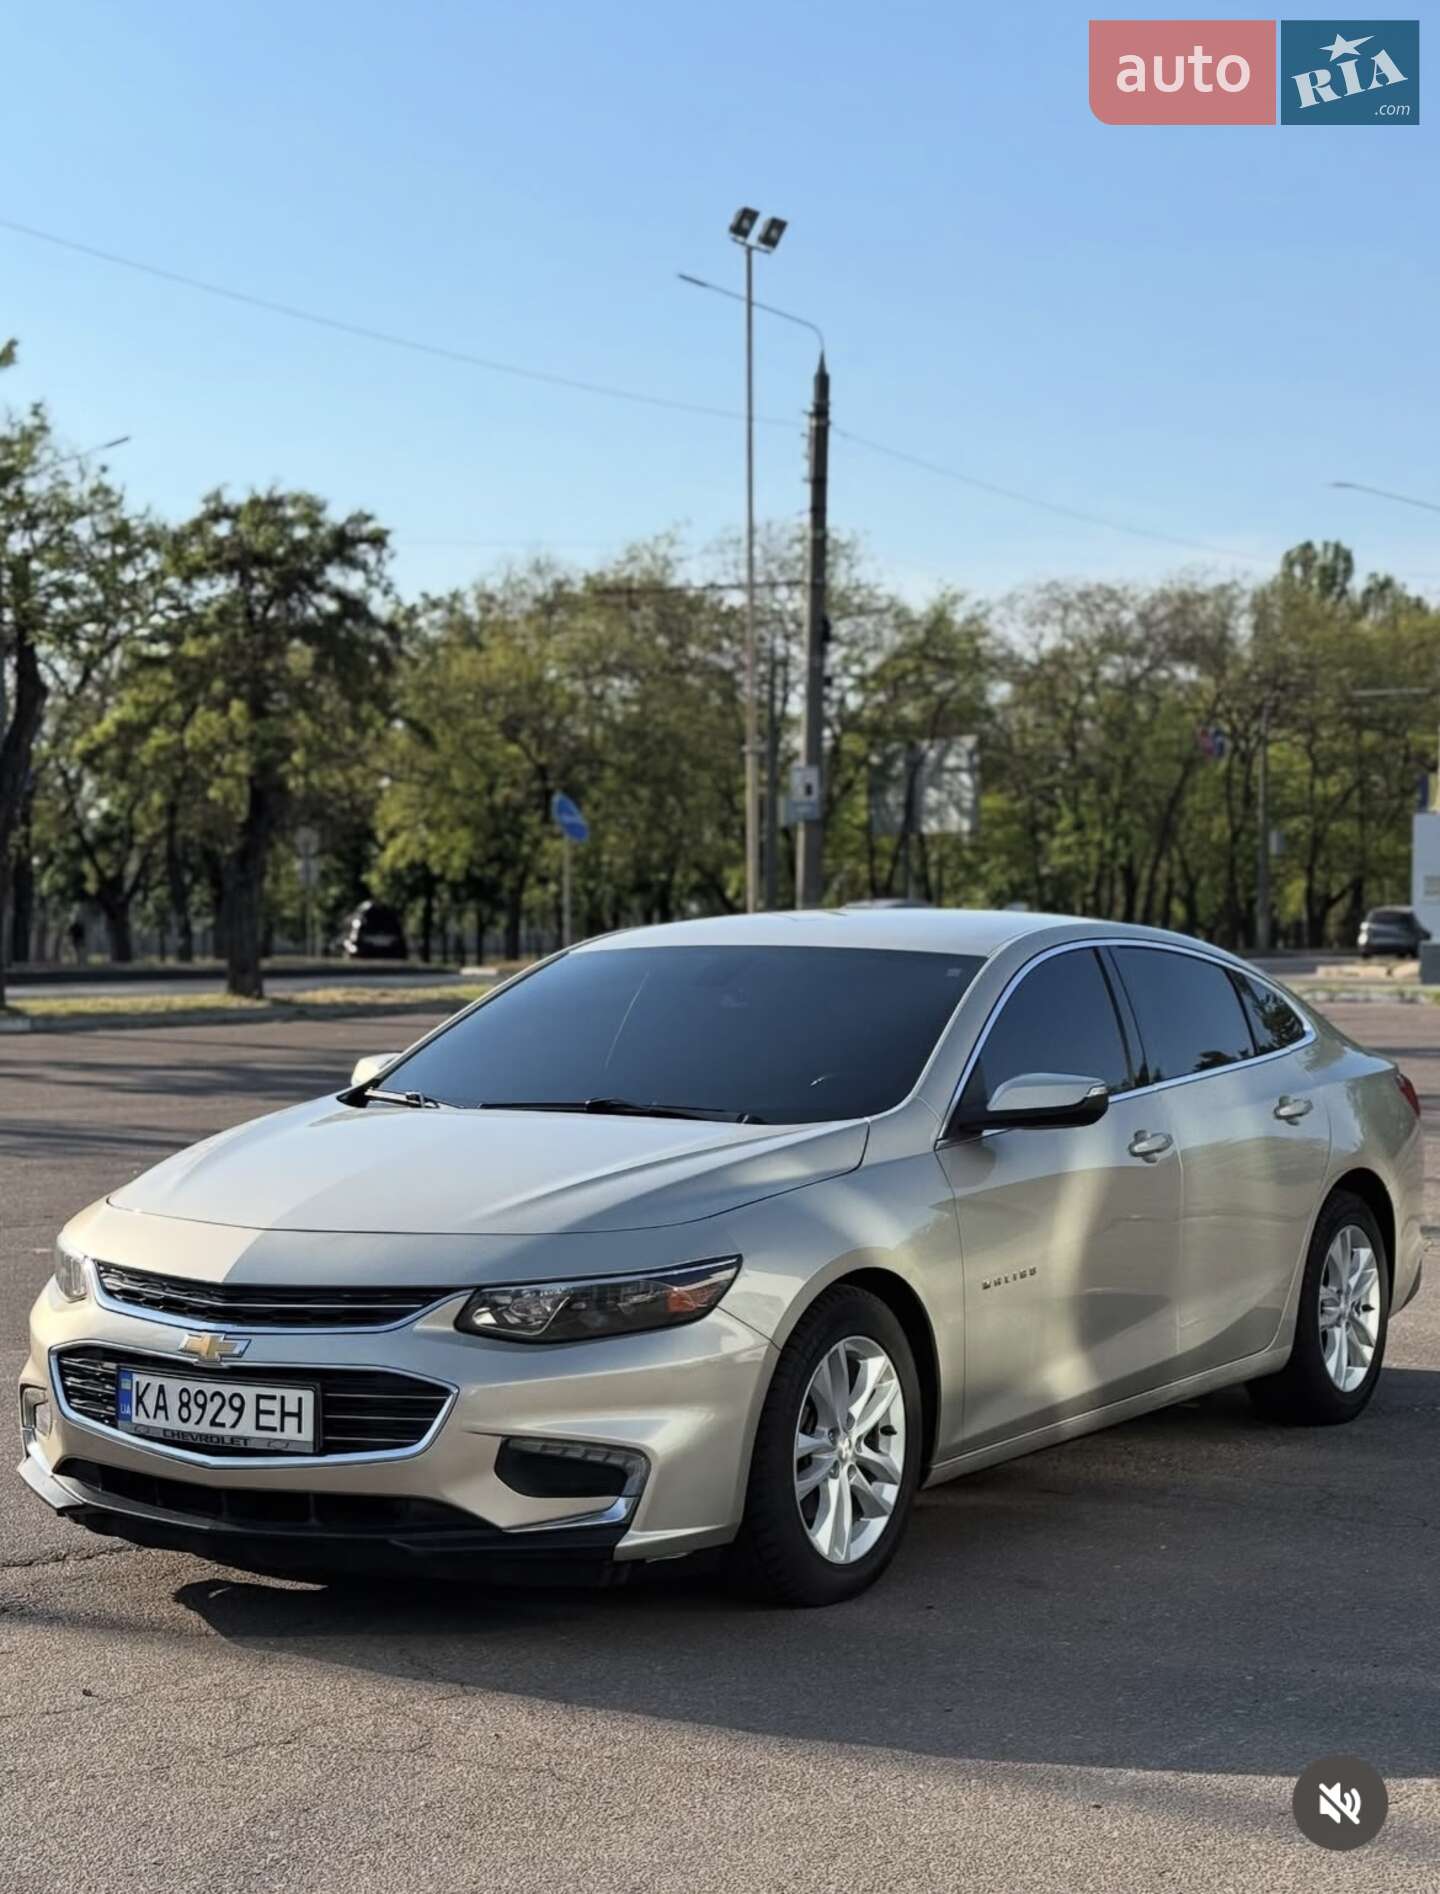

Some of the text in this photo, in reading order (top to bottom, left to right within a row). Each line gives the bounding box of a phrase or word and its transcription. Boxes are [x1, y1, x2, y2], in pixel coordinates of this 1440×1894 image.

[120, 1403, 131, 1415] UA
[135, 1381, 303, 1434] KA 8929 EH
[162, 1429, 250, 1447] CHEVROLET
